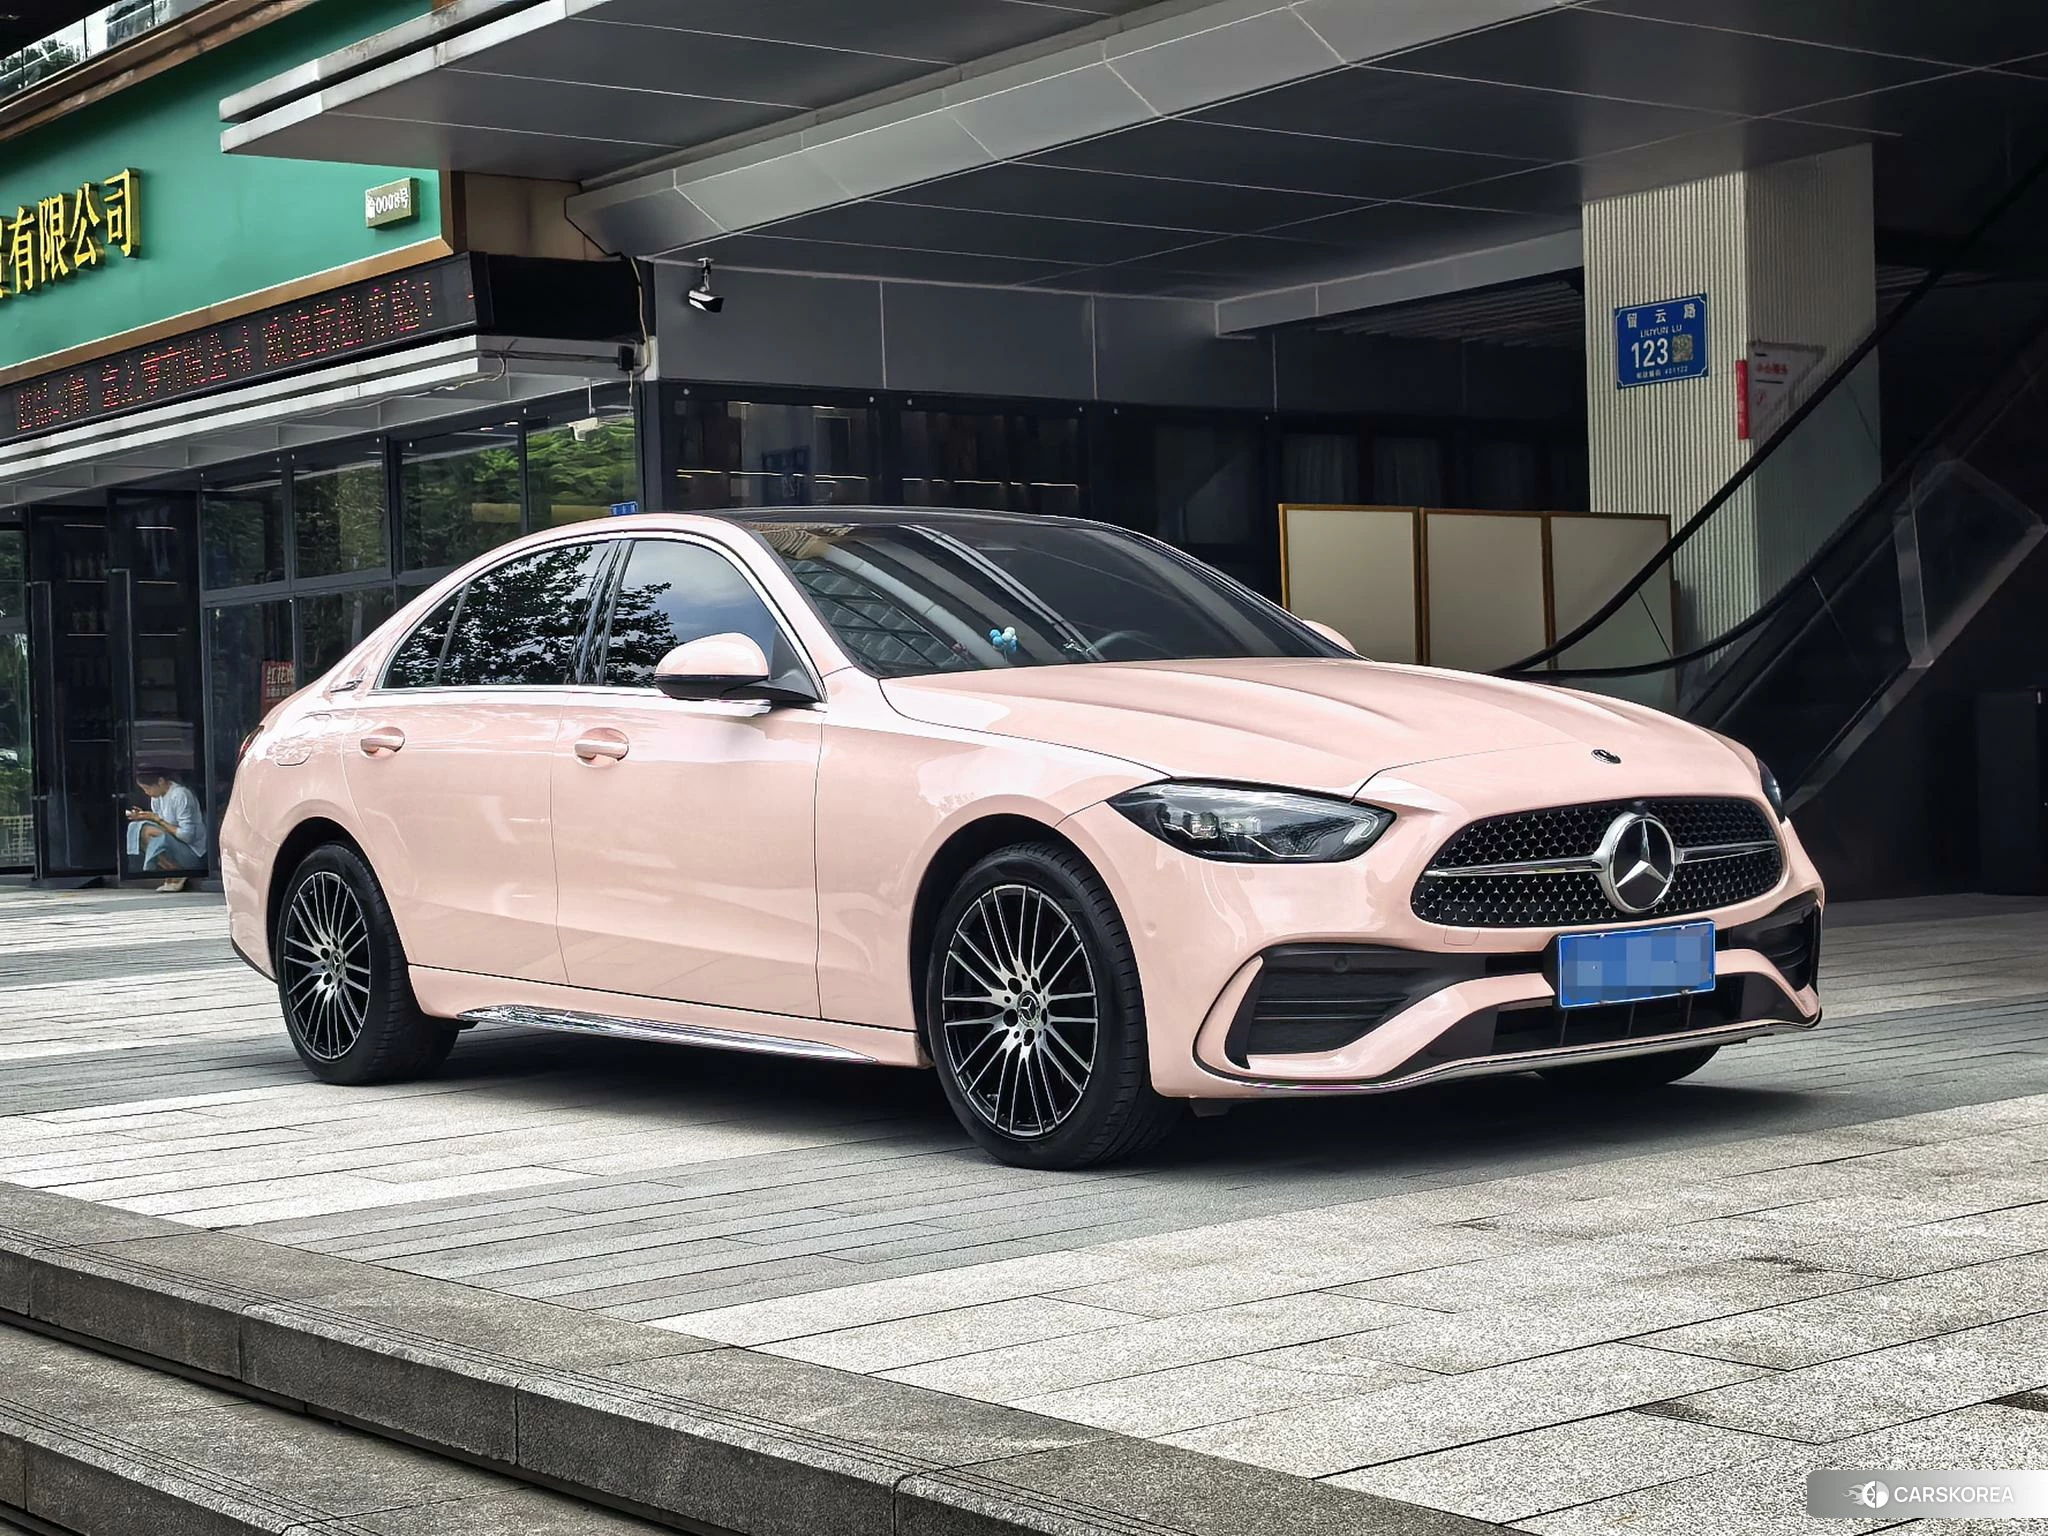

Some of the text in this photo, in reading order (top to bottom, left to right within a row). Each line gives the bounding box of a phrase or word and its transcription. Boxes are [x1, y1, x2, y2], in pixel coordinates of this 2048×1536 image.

[0, 168, 131, 298] 有限公司
[1627, 303, 1695, 328] 留云路
[1672, 324, 1682, 333] LU
[1631, 338, 1668, 368] 123
